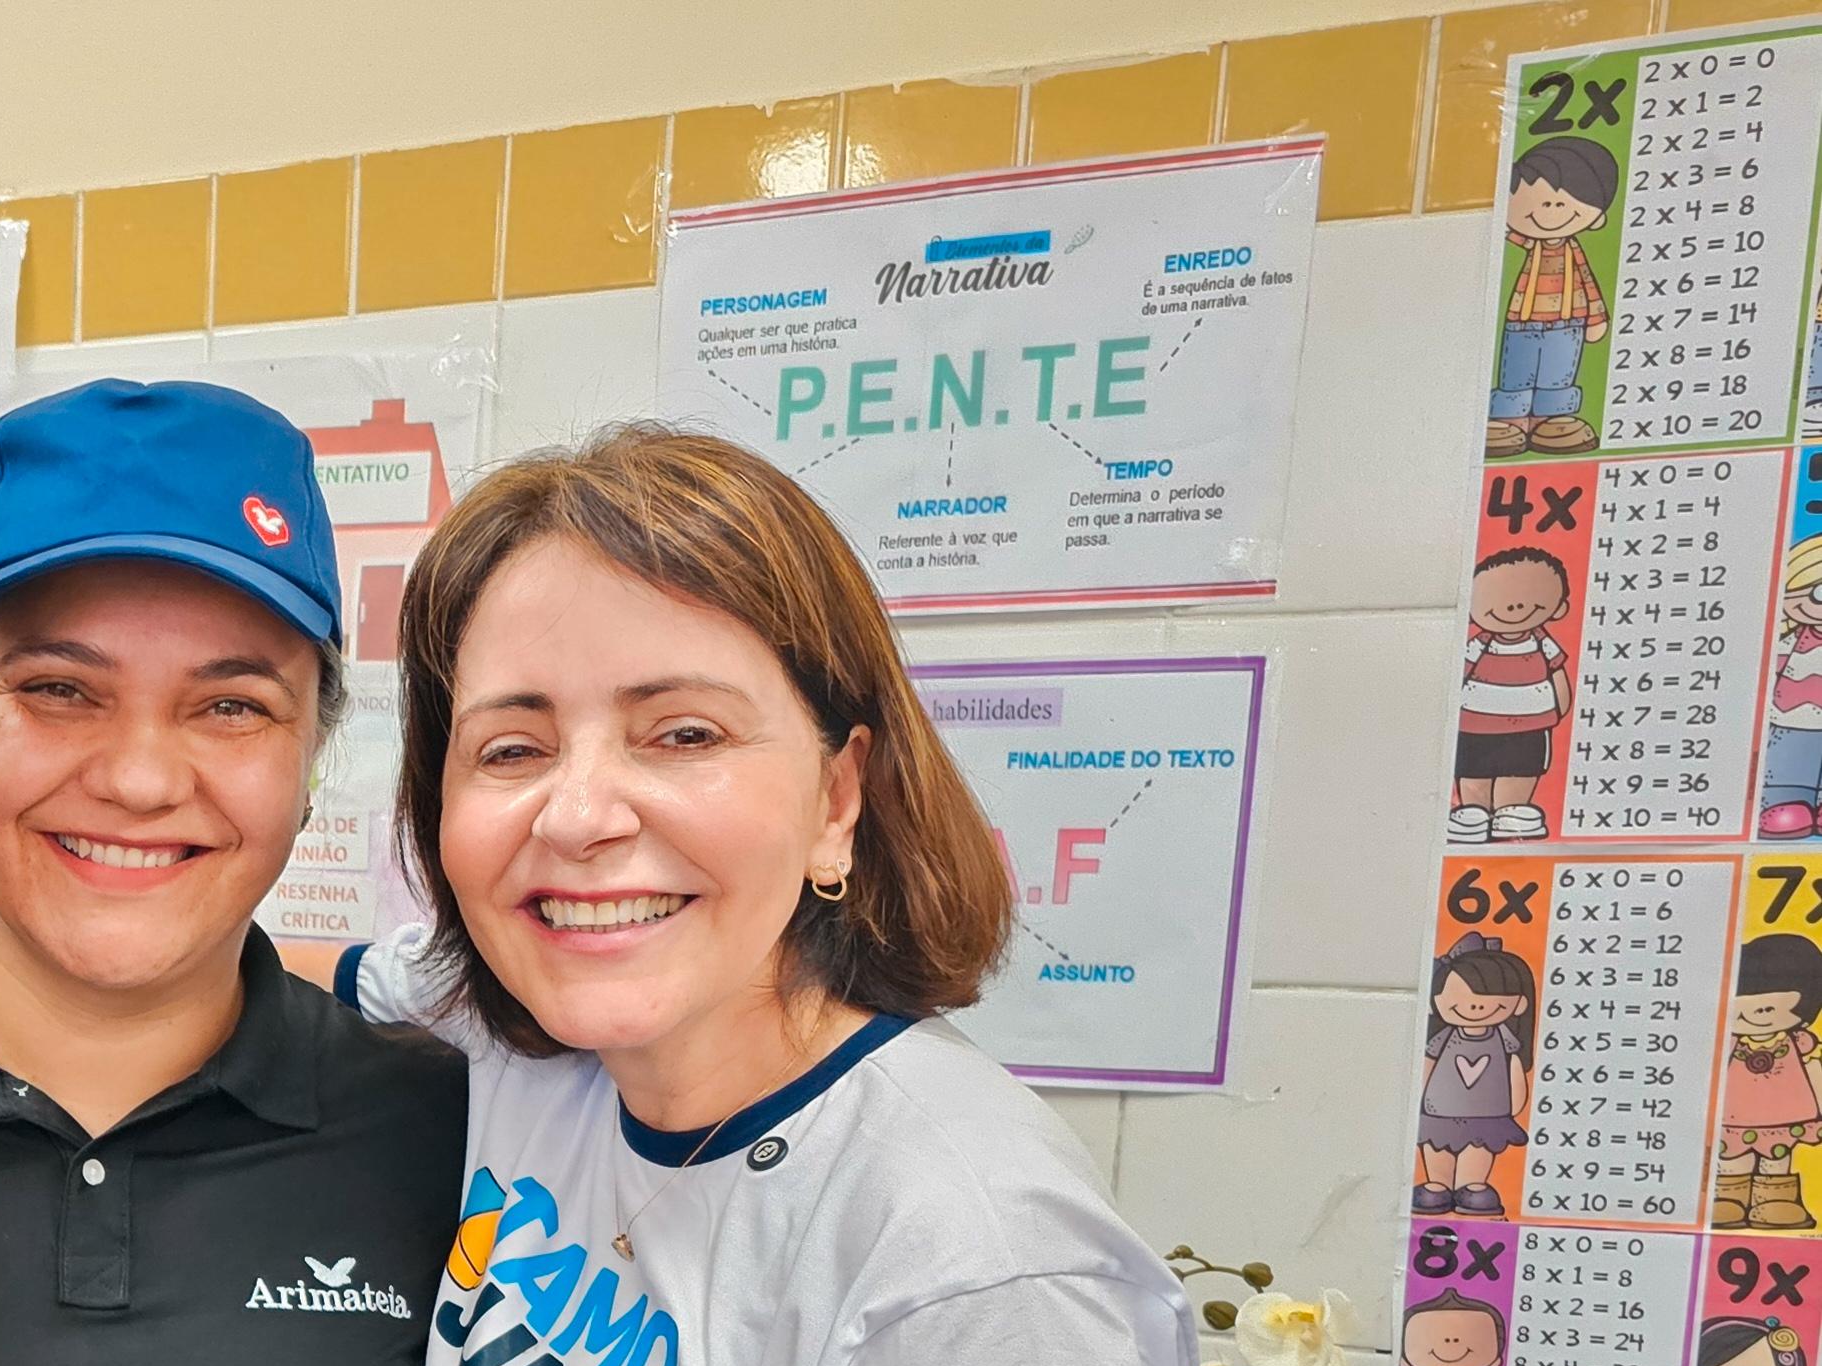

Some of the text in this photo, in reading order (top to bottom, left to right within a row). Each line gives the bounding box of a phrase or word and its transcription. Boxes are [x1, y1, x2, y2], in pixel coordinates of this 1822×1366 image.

[1644, 61, 1661, 84] 2
[1700, 55, 1718, 76] 0
[1757, 47, 1775, 69] 0
[1528, 70, 1628, 136] 2x
[1641, 98, 1657, 120] 2
[1696, 91, 1708, 114] 1
[1745, 85, 1763, 108] 2
[1164, 246, 1252, 273] ENREDO
[1626, 242, 1642, 264] 2
[1680, 236, 1697, 259] 5
[1734, 230, 1765, 253] 10
[874, 255, 1055, 306] Narrativa
[1143, 271, 1293, 297] É a sequência de fatos
[700, 288, 828, 317] PERSONAGEM
[1141, 294, 1249, 316] de uma narrativa.
[698, 316, 857, 343] Qualquer ser que pratica
[697, 346, 733, 364] ações
[737, 345, 757, 357] em
[759, 343, 788, 356] uma
[776, 336, 1151, 441] P.E.N.T.E
[1608, 419, 1624, 440] 2
[1662, 415, 1691, 436] 10
[1728, 409, 1762, 431] 20
[1104, 458, 1173, 480] TEMPO
[1605, 468, 1621, 488] 4
[1659, 465, 1677, 484] 0
[1714, 461, 1732, 481] 0
[897, 495, 1007, 519] NARRADOR
[1069, 483, 1225, 507] Determina o período
[1487, 475, 1583, 535] 4x
[1067, 506, 1223, 528] em que a narrativa se
[878, 530, 1018, 550] Referente à voz que
[1065, 533, 1110, 551] passa.
[877, 552, 980, 571] conta a história.
[1587, 640, 1603, 660] 4
[1640, 637, 1656, 659] 5
[1692, 636, 1725, 656] 20
[932, 697, 1053, 724] habilidades
[1007, 749, 1235, 770] FINALIDADE DO TEXTO
[1569, 808, 1585, 828] 4
[1622, 807, 1651, 828] 10
[1688, 807, 1720, 827] 40
[1559, 869, 1575, 888] 6
[1613, 869, 1630, 888] 0
[1666, 869, 1683, 888] 0
[277, 882, 359, 904] RESENHA
[1446, 868, 1539, 925] 6x
[1038, 963, 1136, 984] ASSUNTO
[1544, 1031, 1559, 1050] 6
[1595, 1032, 1611, 1052] 5
[1646, 1033, 1678, 1053] 30
[1528, 1190, 1544, 1209] 6
[1580, 1192, 1608, 1212] 10
[1642, 1195, 1676, 1215] 60
[1413, 1225, 1506, 1282] 8x
[1524, 1232, 1539, 1250] 8
[1576, 1236, 1592, 1253] 0
[1627, 1238, 1644, 1256] 0
[1716, 1247, 1811, 1307] 9x
[244, 1277, 412, 1320] Arimateia
